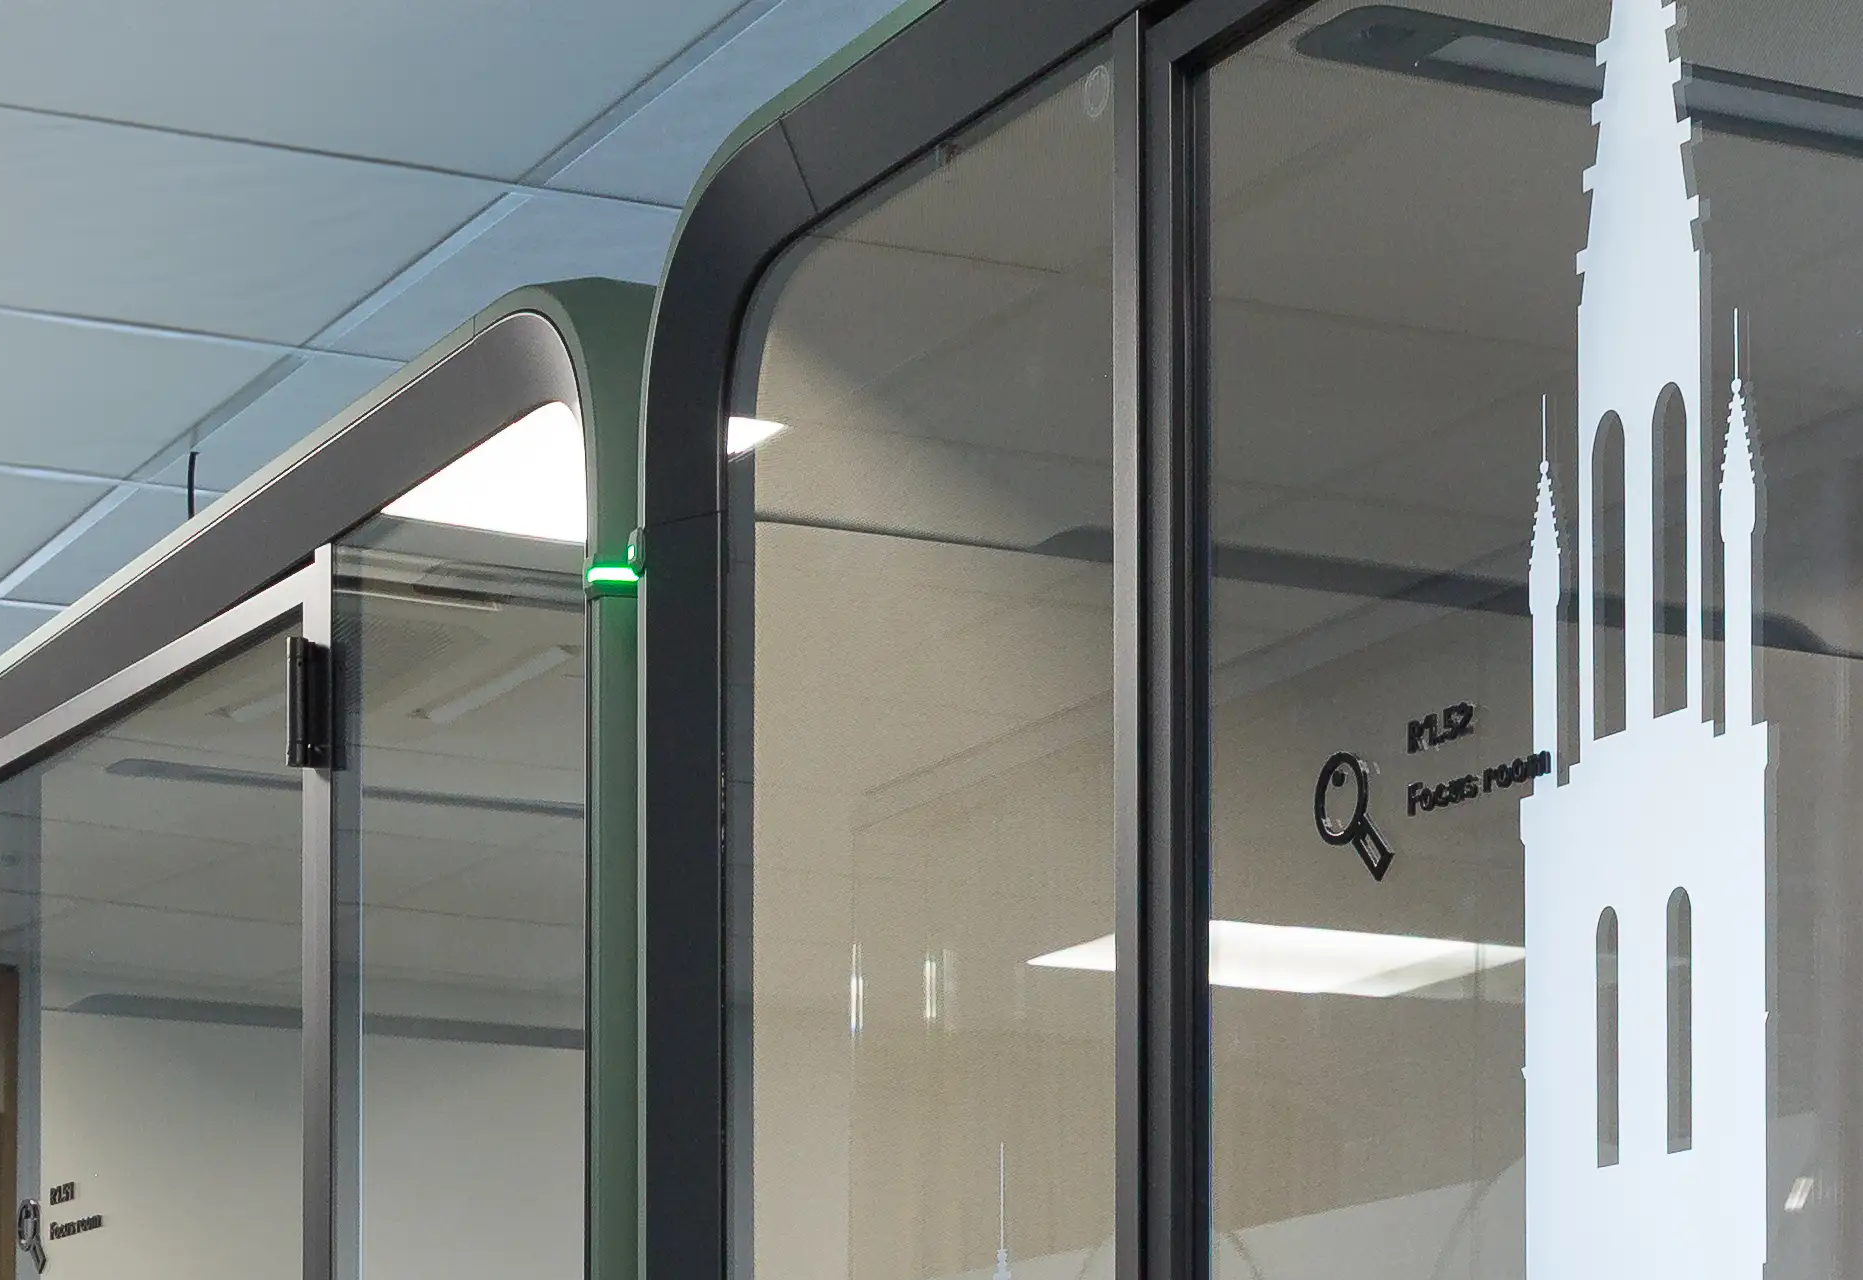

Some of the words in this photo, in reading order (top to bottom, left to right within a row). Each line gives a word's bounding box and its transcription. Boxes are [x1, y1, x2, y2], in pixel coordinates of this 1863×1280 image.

[1406, 774, 1479, 817] Focus
[1483, 750, 1552, 793] room
[49, 1221, 76, 1241] Focus
[76, 1214, 103, 1233] room
